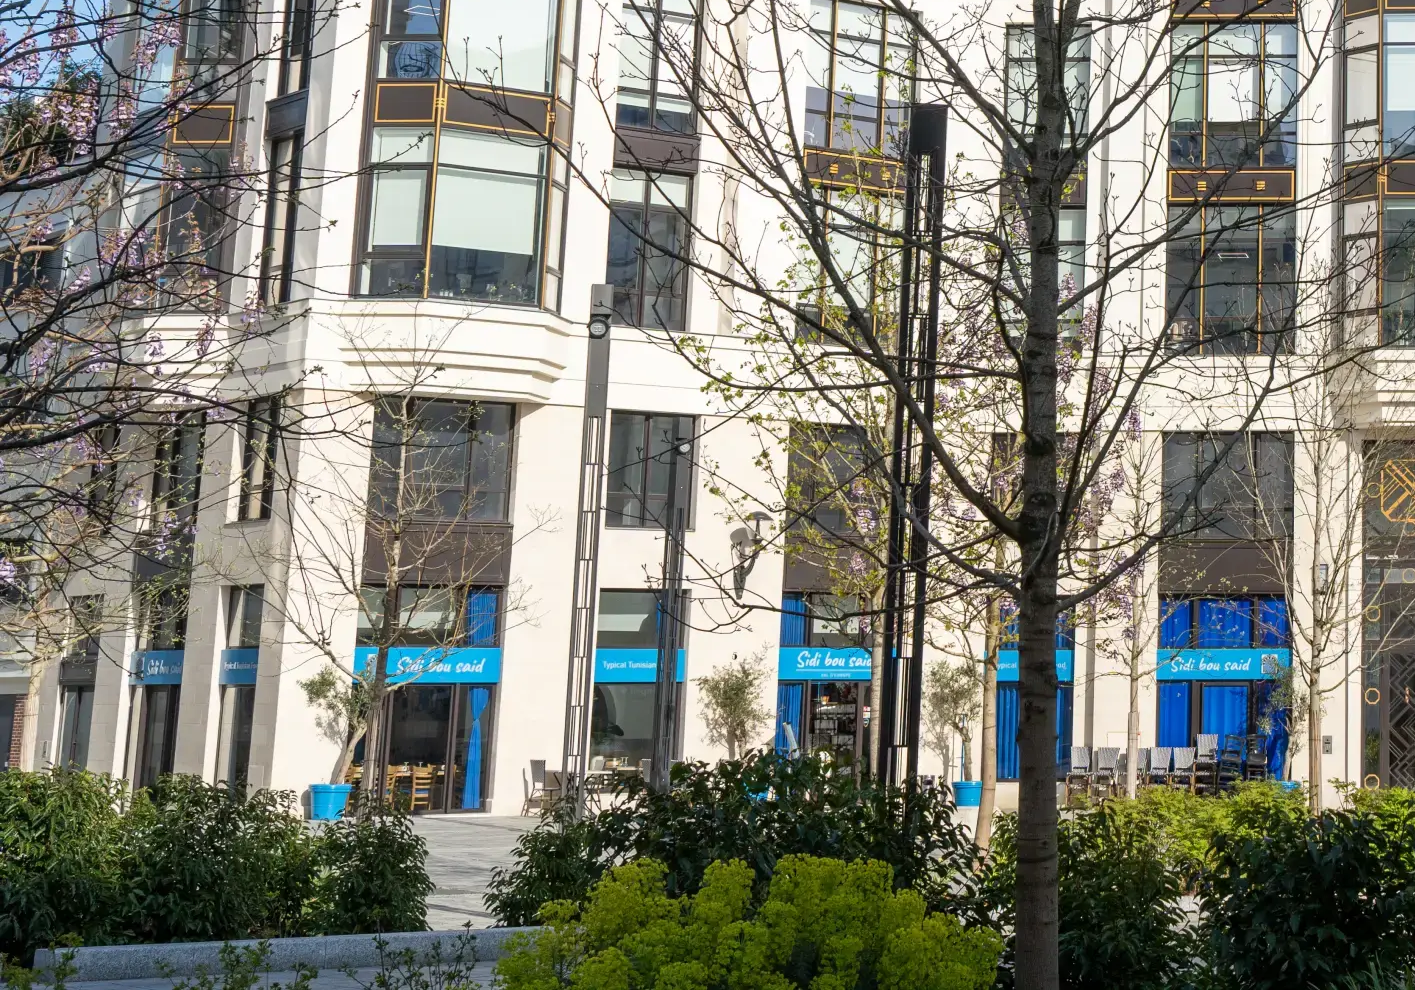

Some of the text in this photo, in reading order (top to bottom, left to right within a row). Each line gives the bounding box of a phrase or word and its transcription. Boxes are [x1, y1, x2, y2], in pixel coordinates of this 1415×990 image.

[455, 658, 486, 673] said
[602, 660, 627, 670] Typical
[628, 660, 657, 669] Tunisian
[796, 650, 822, 668] Sidi
[824, 652, 845, 667] bou
[996, 661, 1017, 670] ypical
[1170, 656, 1252, 672] Sidi bou said
